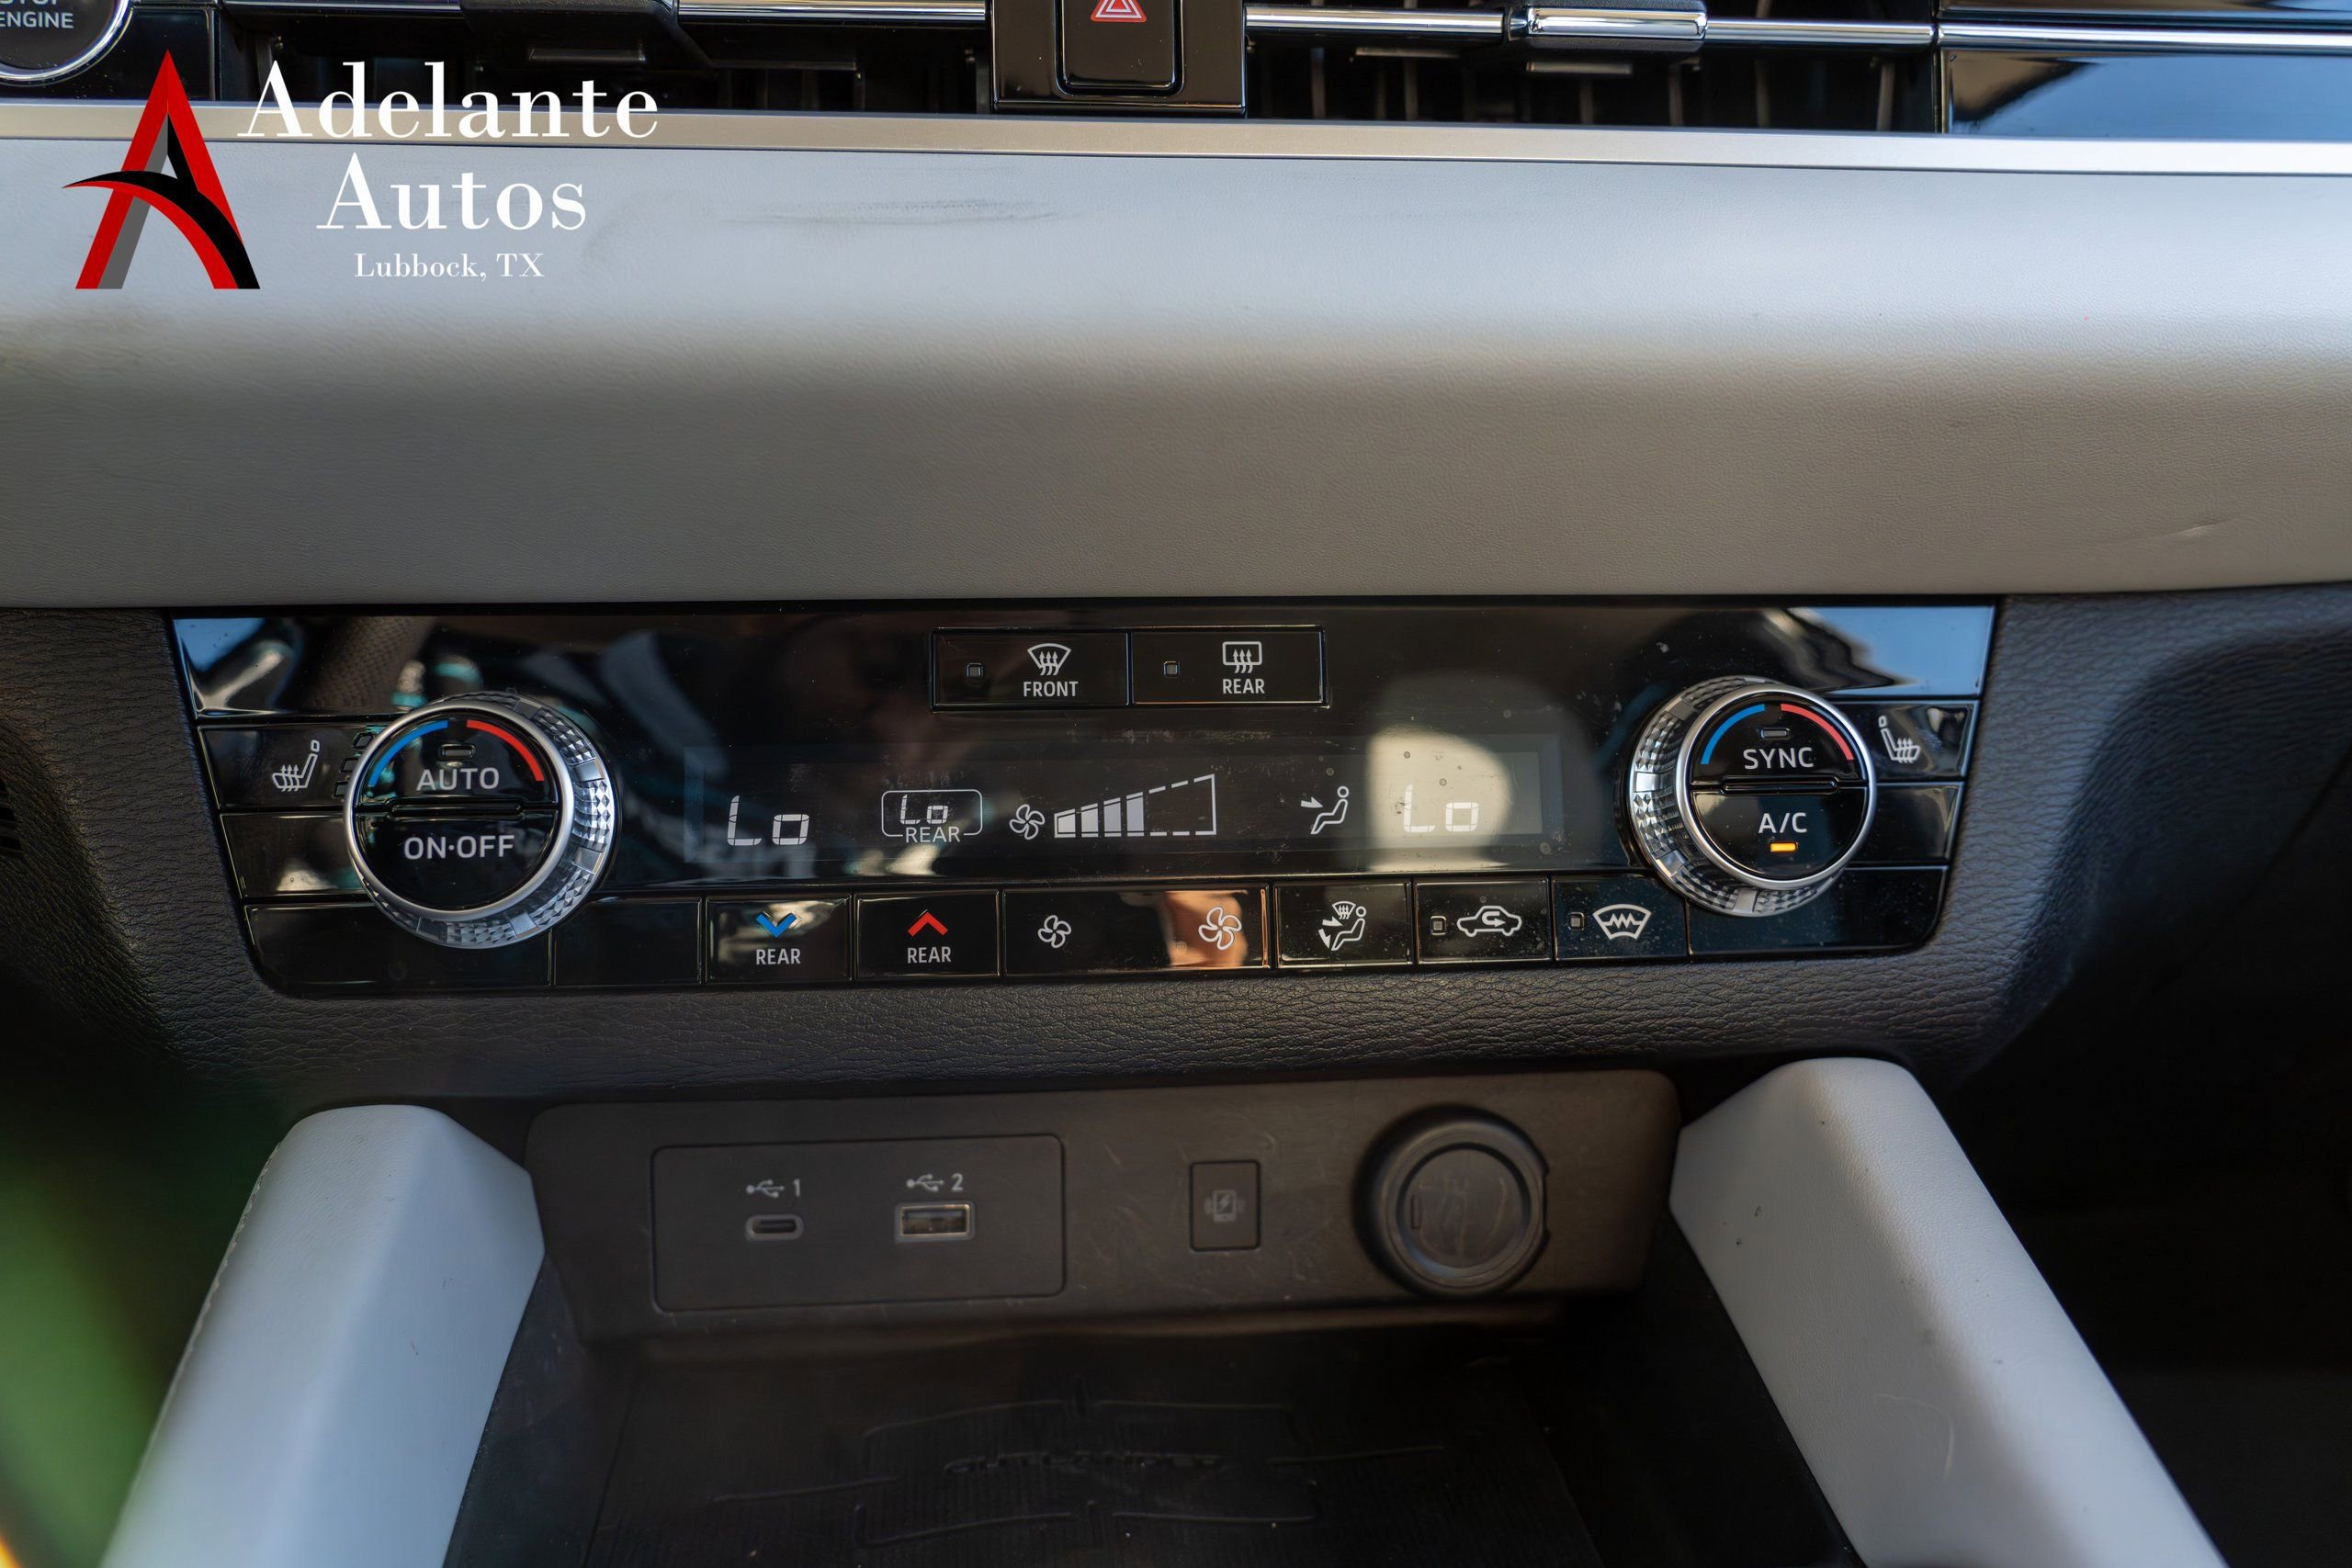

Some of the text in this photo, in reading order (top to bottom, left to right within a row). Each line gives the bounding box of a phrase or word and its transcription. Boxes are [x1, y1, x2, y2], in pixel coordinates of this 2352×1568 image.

[1023, 681, 1079, 697] FRONT
[1222, 678, 1266, 694] REAR
[1742, 747, 1815, 770] SYNC
[416, 767, 501, 792] AUTO
[1758, 812, 1808, 834] A/C
[905, 826, 961, 843] REAR
[755, 948, 801, 965] REAR
[907, 946, 952, 964] REAR
[793, 1179, 800, 1196] 1
[951, 1172, 964, 1192] 2
